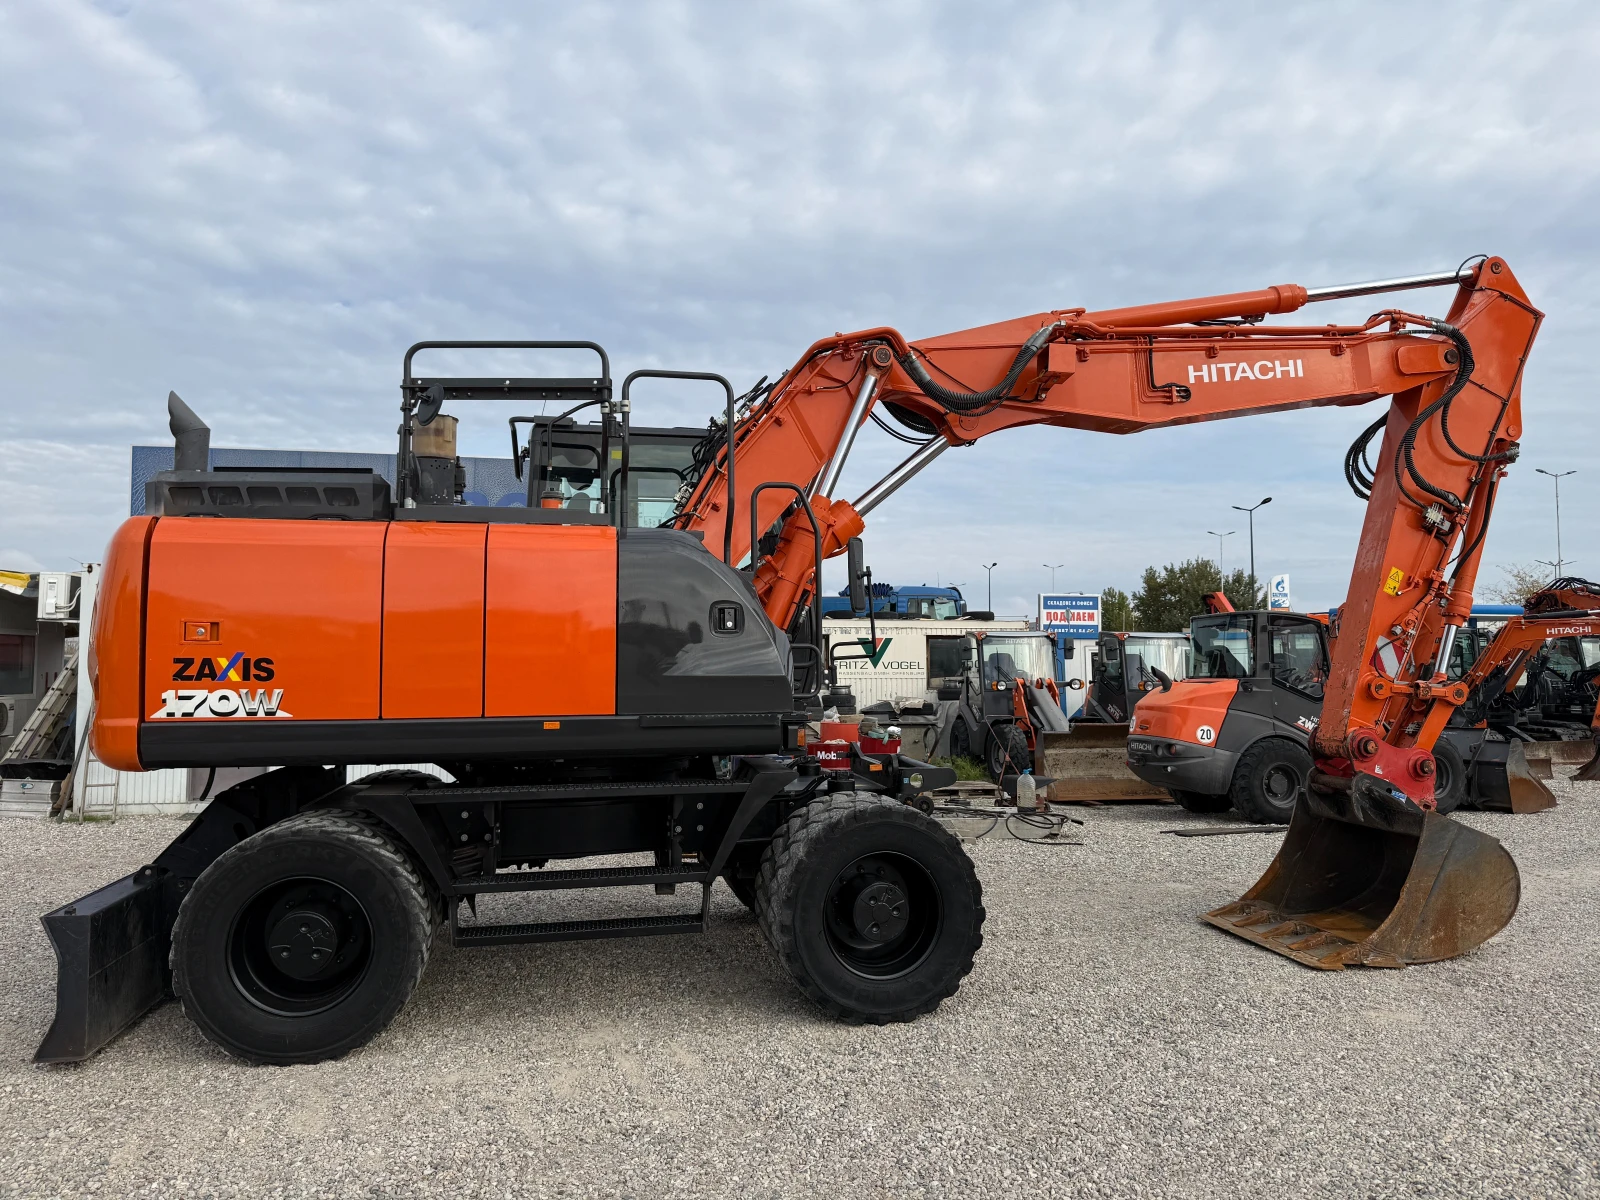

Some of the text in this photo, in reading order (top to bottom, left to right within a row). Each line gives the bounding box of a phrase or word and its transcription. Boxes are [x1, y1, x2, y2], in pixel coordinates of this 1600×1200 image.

[1187, 359, 1304, 384] HITACHI
[1046, 611, 1067, 623] ПОД
[1546, 625, 1592, 635] HITACHI
[172, 651, 275, 682] ZAXIS
[881, 660, 925, 670] VOGEL
[161, 688, 285, 717] 170W
[1297, 715, 1318, 730] ZW
[1200, 728, 1212, 740] 20
[1130, 742, 1152, 752] HITACHI
[816, 750, 843, 760] Mob
